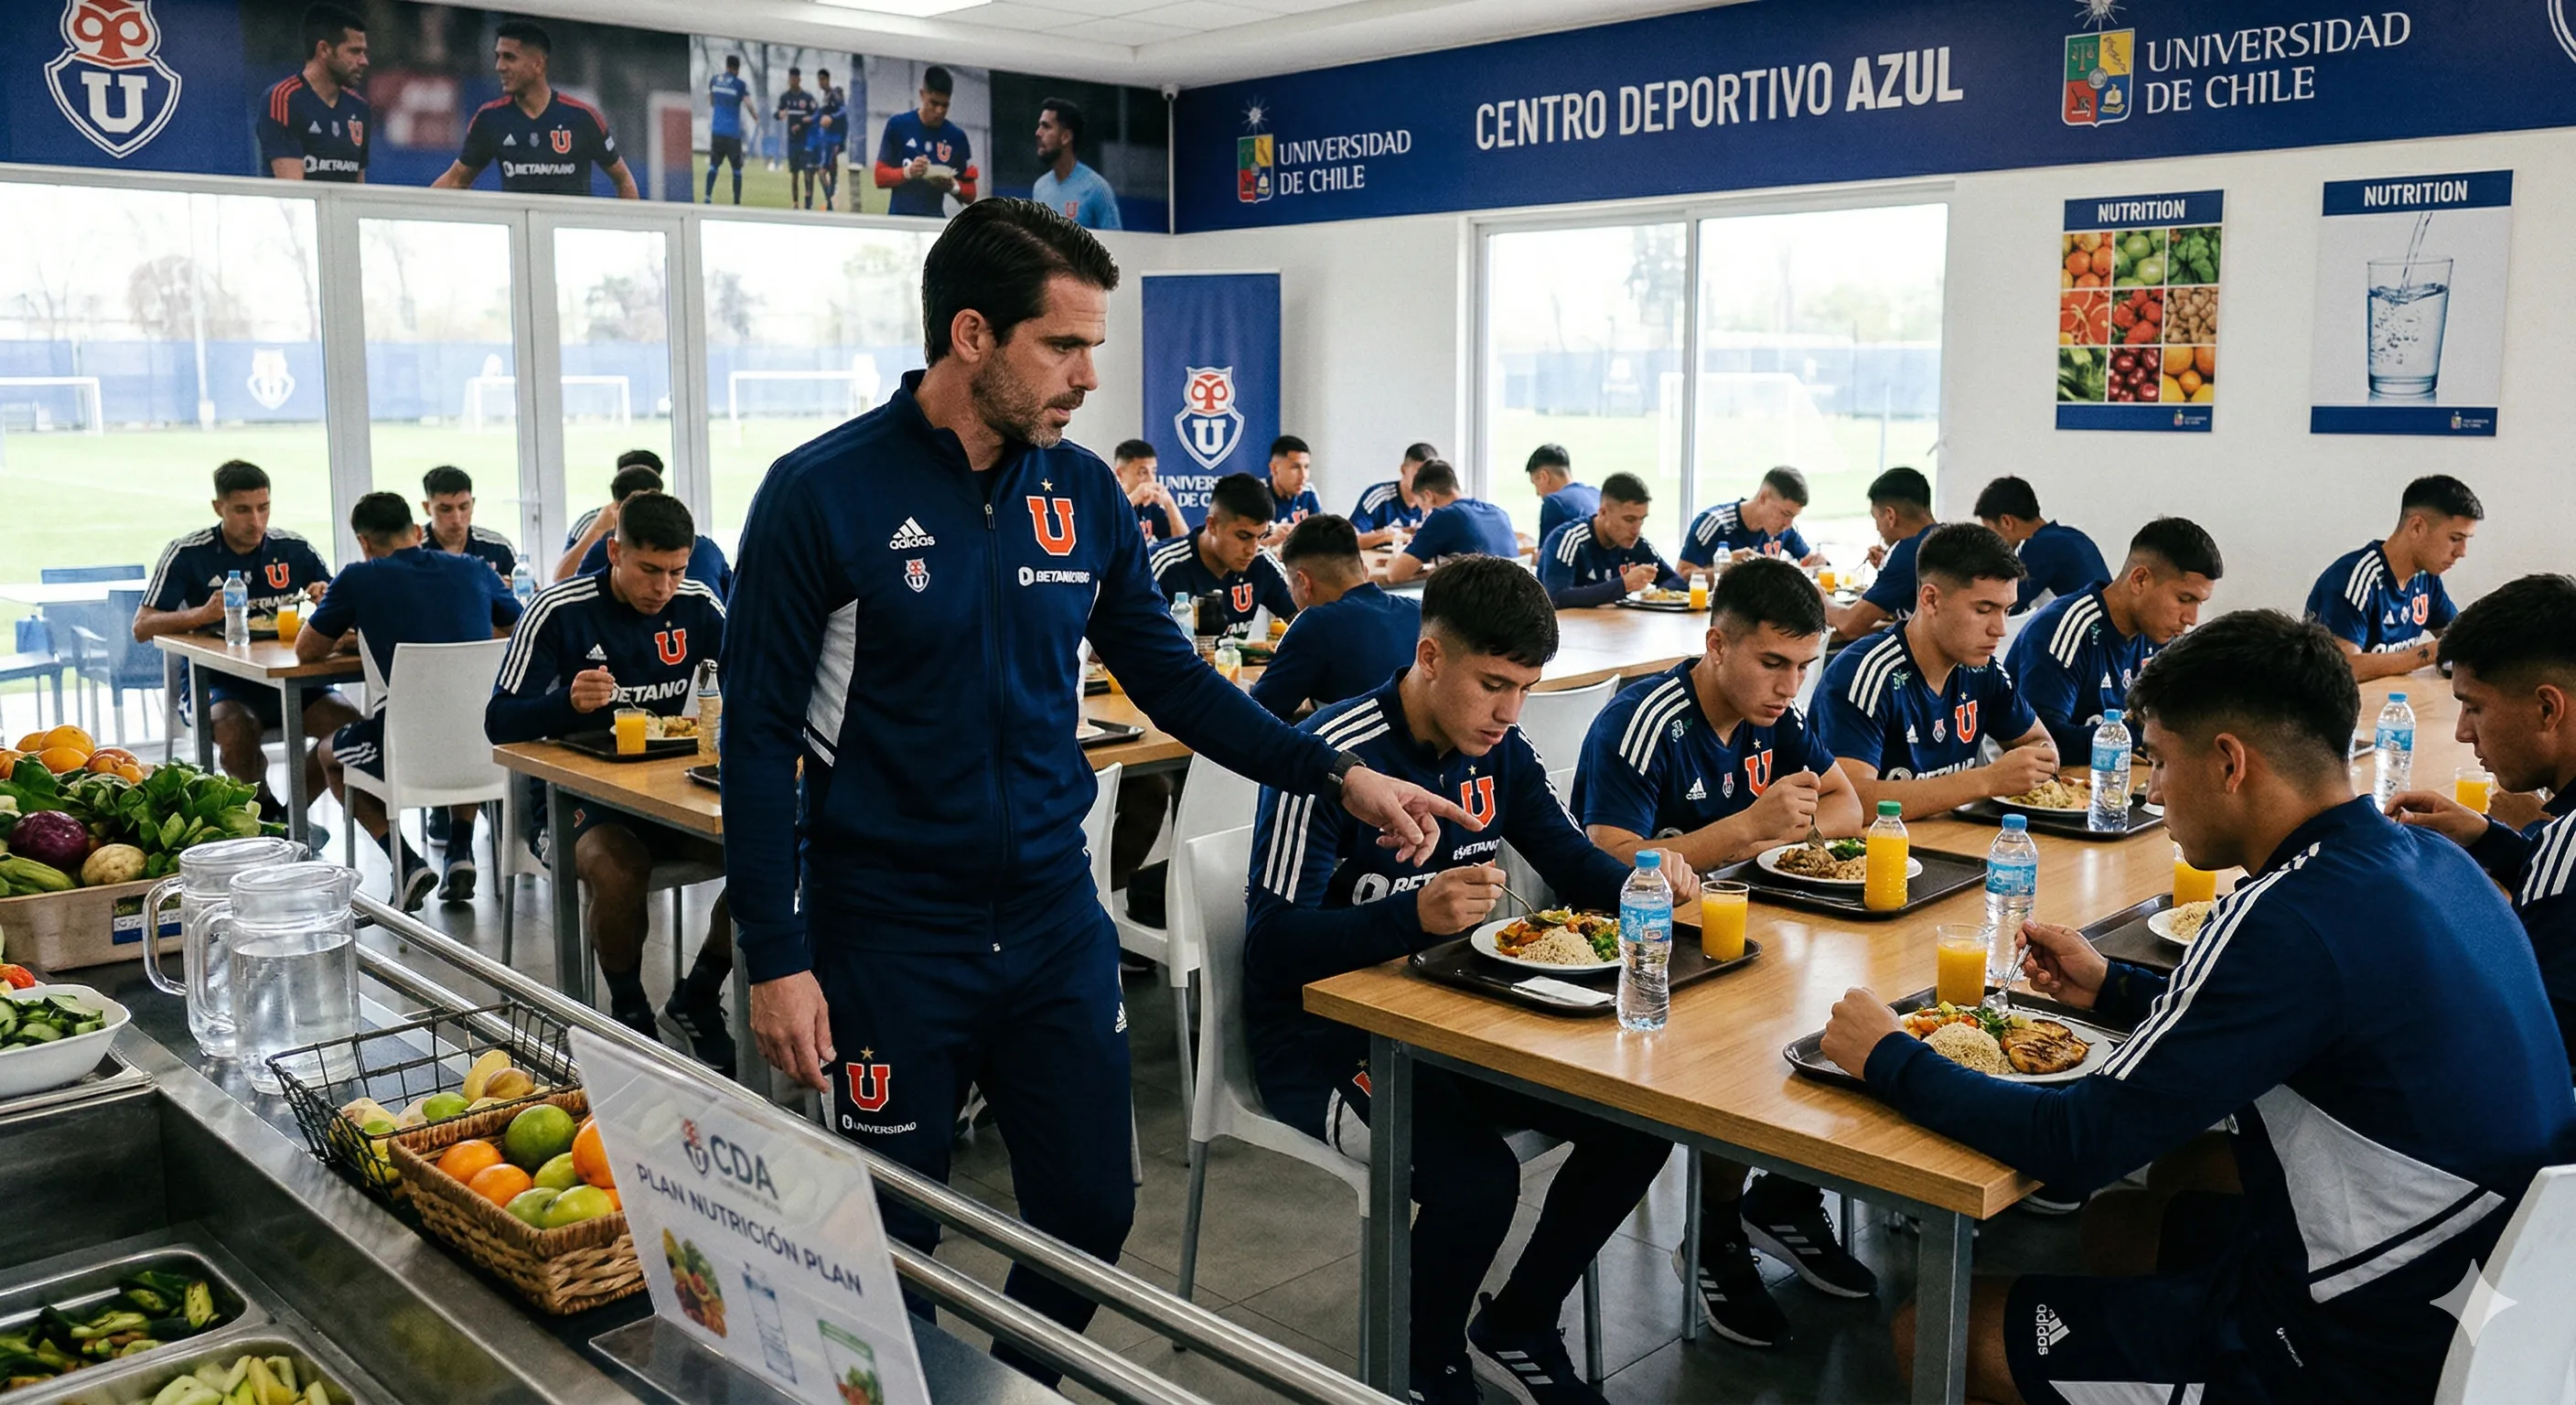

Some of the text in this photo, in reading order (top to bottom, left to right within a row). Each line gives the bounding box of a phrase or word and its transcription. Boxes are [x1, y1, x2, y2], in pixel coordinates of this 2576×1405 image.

[2146, 11, 2411, 72] UNIVERSIDAD
[80, 70, 148, 134] U
[1475, 46, 1964, 151] CENTRO DEPORTIVO AZUL
[2145, 65, 2315, 114] DE CHILE
[1279, 129, 1412, 166] UNIVERSIDAD
[1279, 165, 1366, 196] DE CHILE
[2364, 180, 2469, 208] NUTRITION
[2097, 199, 2186, 223] NUTRITION
[1192, 418, 1227, 455] U
[1177, 492, 1198, 508] DE
[888, 535, 936, 551] adidas
[1026, 495, 1077, 556] U
[264, 563, 290, 590] U
[1231, 582, 1253, 613] U
[654, 627, 688, 666] U
[1954, 699, 1979, 744] U
[1744, 748, 1773, 798] U
[1460, 775, 1496, 828] U
[846, 1062, 891, 1112] U
[710, 1134, 780, 1201] CDA
[636, 1162, 686, 1206] PLAN
[688, 1188, 800, 1265] NUTRICIÓN
[802, 1247, 864, 1296] PLAN
[2035, 1303, 2049, 1356] adidas
